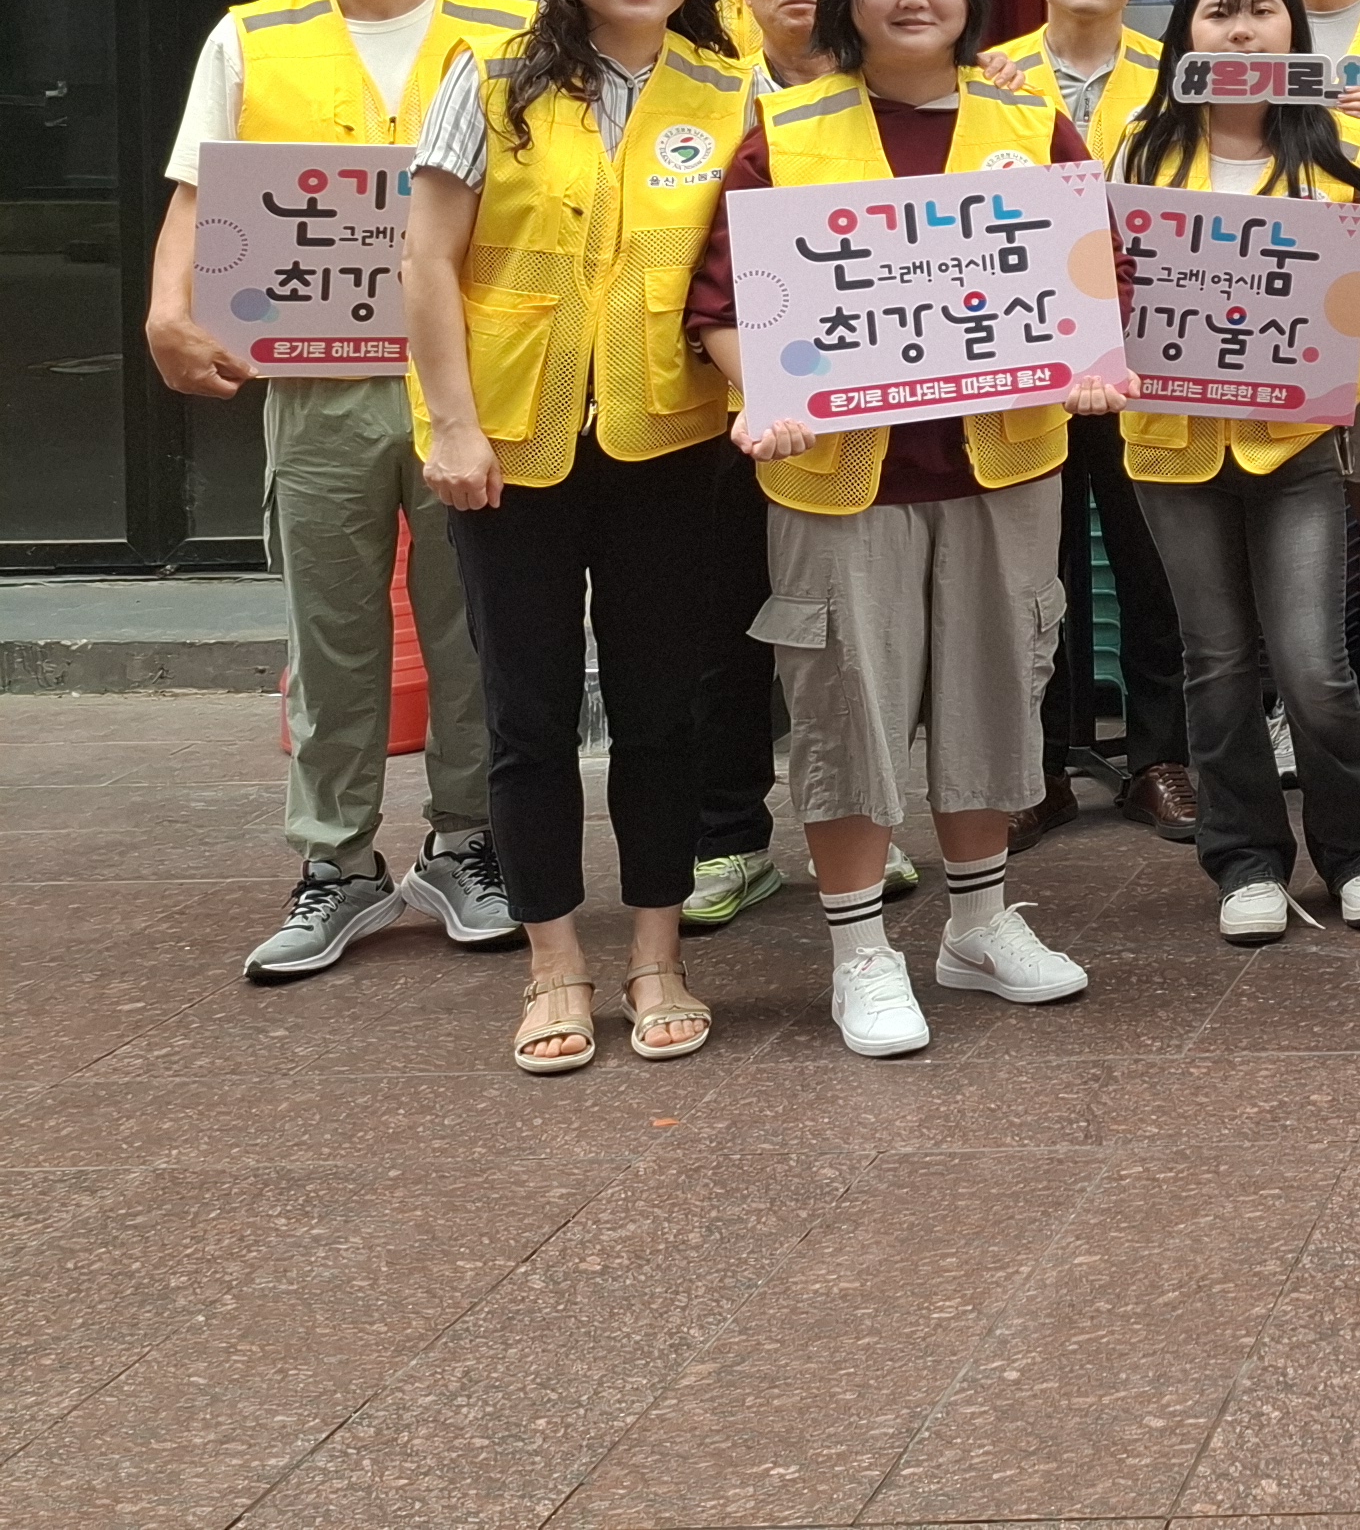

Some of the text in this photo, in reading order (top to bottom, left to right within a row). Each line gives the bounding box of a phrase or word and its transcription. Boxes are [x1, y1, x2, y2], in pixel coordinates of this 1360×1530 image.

[262, 169, 410, 248] 온기
[338, 226, 394, 248] 그래!
[796, 194, 1052, 291] 온기나눔
[1125, 208, 1320, 297] 온기나눔
[877, 253, 996, 288] 그래! 역시!
[1157, 267, 1262, 301] 그래! 역시!
[273, 341, 400, 358] 온기로 하나되는
[830, 368, 1051, 411] 온기로 하나되는 따뜻한 울산
[1143, 379, 1287, 404] 하나되는 따뜻한 울산
